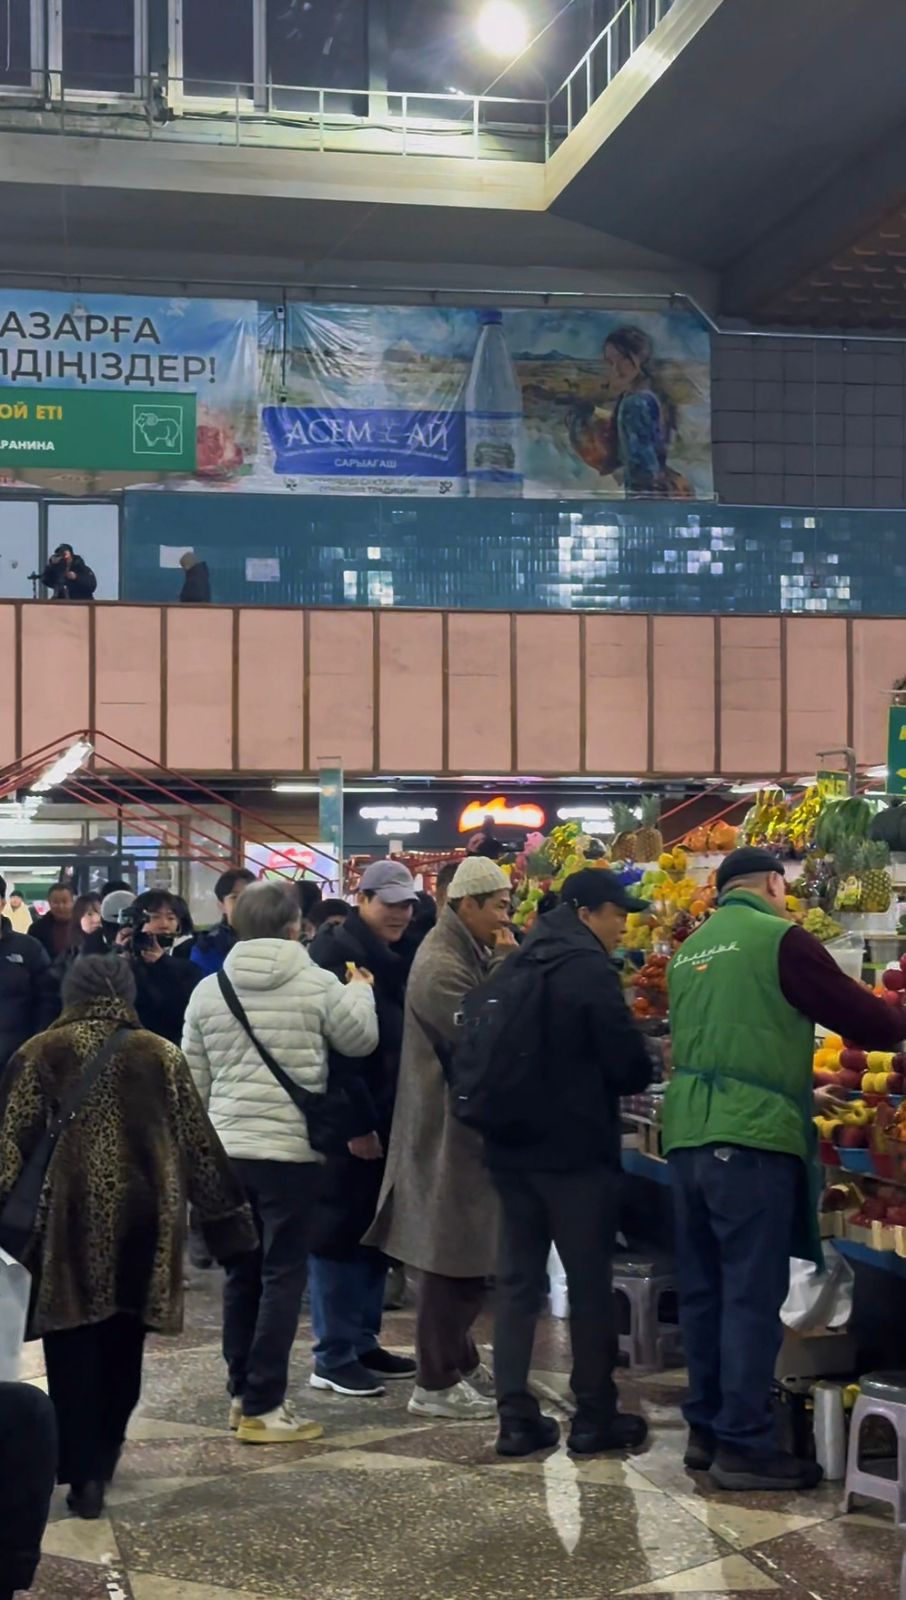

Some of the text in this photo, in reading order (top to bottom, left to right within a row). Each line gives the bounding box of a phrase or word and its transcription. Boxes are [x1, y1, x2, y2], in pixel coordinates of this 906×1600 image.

[0, 310, 160, 345] АЗАРҒА
[0, 401, 63, 421] ОЙ ЕТІ
[0, 439, 55, 451] РАНИНА
[283, 417, 372, 448] АСЕМ
[404, 420, 449, 451] АЙ
